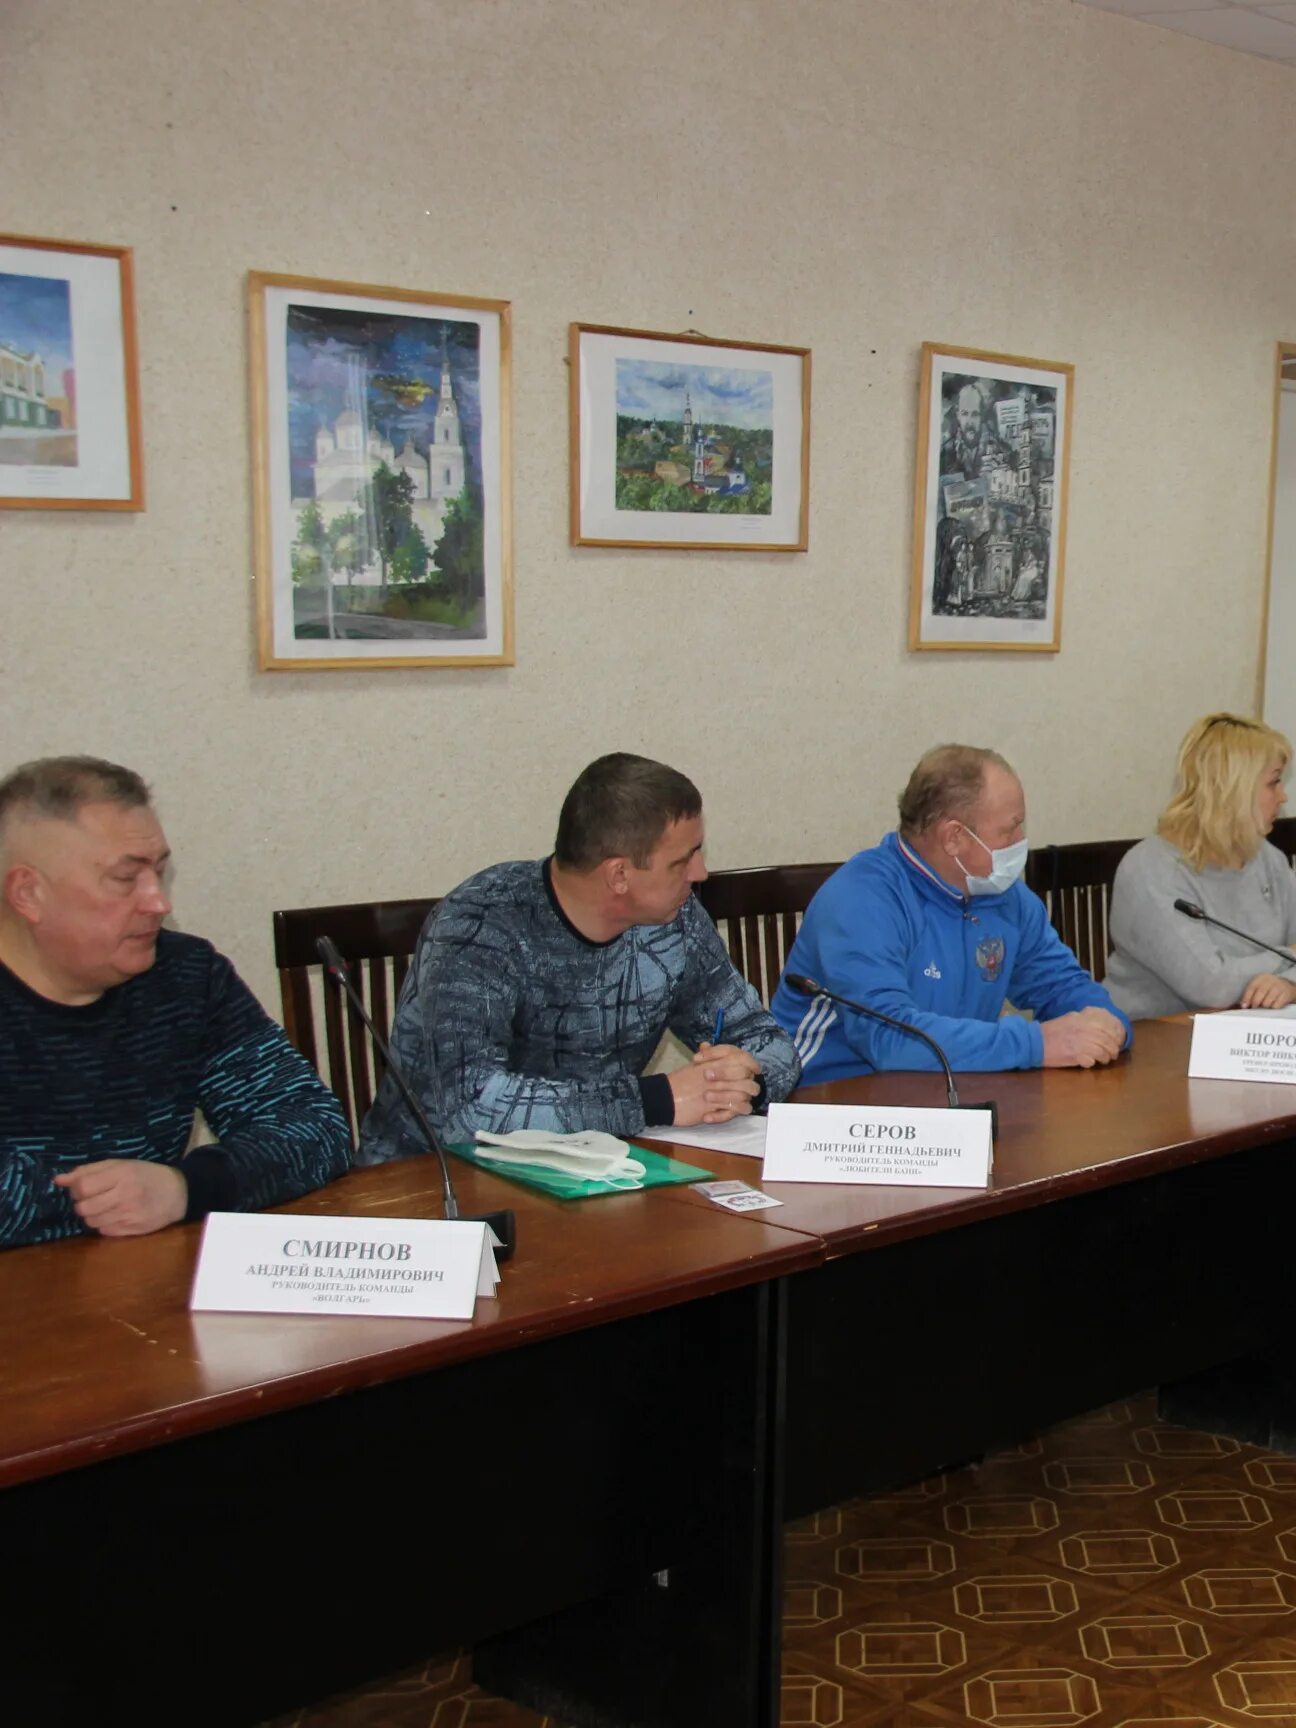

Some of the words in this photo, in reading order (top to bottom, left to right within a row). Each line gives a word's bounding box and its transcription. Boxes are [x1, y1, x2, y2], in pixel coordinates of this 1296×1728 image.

[1229, 1048, 1271, 1058] ВИКТОР
[849, 1123, 916, 1140] СЕРОВ
[803, 1141, 866, 1154] ДМИТРИЙ
[869, 1145, 961, 1158] ГЕННАДЬЕВИЧ
[824, 1155, 891, 1166] РУКОВОДИТЕЛЬ
[893, 1158, 939, 1167] КОМАНДЫ
[282, 1239, 412, 1261] СМИРНОВ
[246, 1263, 309, 1277] АНДРЕЙ
[313, 1267, 444, 1282] ВЛАДИМИРОВИЧ
[272, 1281, 356, 1293] РУКОВОДИТЕЛЬ
[358, 1284, 414, 1294] КОМАНДЫ
